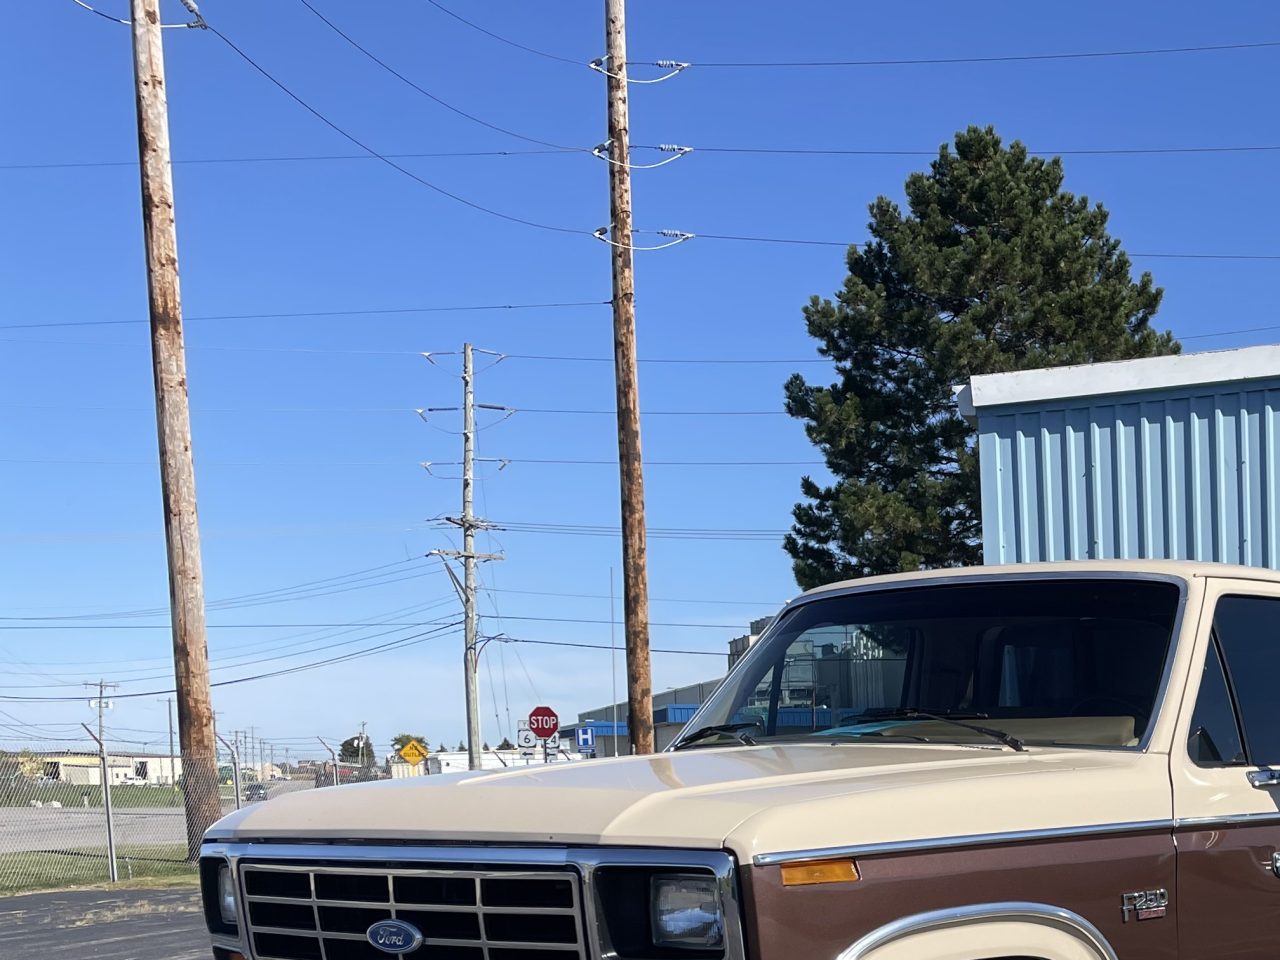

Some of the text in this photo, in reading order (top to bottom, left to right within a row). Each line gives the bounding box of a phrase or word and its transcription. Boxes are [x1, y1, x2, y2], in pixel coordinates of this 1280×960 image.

[530, 716, 557, 729] STOP
[523, 734, 531, 744] 6
[578, 729, 593, 746] H
[1122, 888, 1169, 923] F250
[377, 926, 405, 946] Ford
